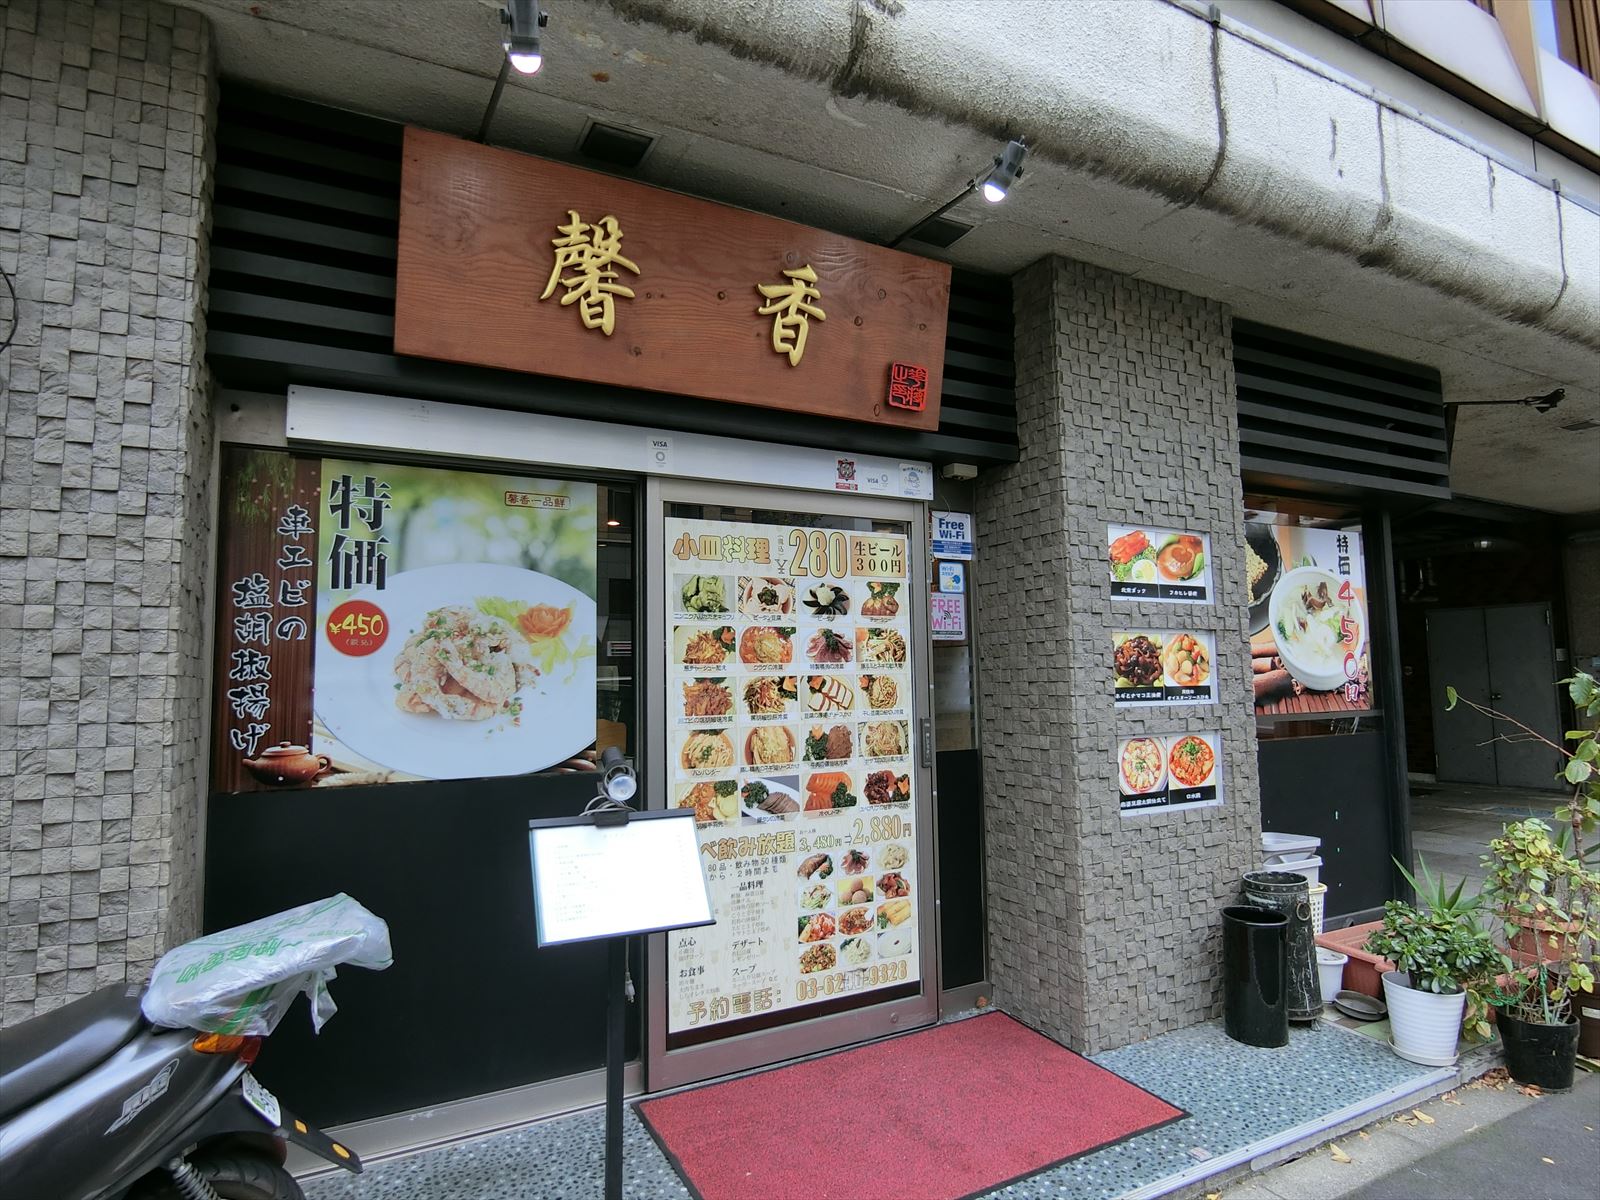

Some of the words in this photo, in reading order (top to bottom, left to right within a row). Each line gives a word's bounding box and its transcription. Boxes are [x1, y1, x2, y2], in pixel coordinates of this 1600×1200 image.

[938, 518, 965, 530] Free
[327, 474, 393, 592] 特価
[938, 530, 965, 540] Wi-Fi
[672, 532, 771, 564] 小皿料理
[854, 541, 903, 557] 生ビール
[276, 504, 316, 641] 車エビの
[856, 558, 901, 573] 300円
[329, 613, 384, 636] ¥450
[932, 616, 962, 630] Wi-Fi
[227, 573, 274, 757] 塩胡椒揚げ
[852, 814, 911, 846] 2,880円
[730, 880, 764, 891] 一品料理
[732, 937, 764, 950] デザート
[679, 965, 705, 978] お食事
[732, 963, 757, 977] スープ
